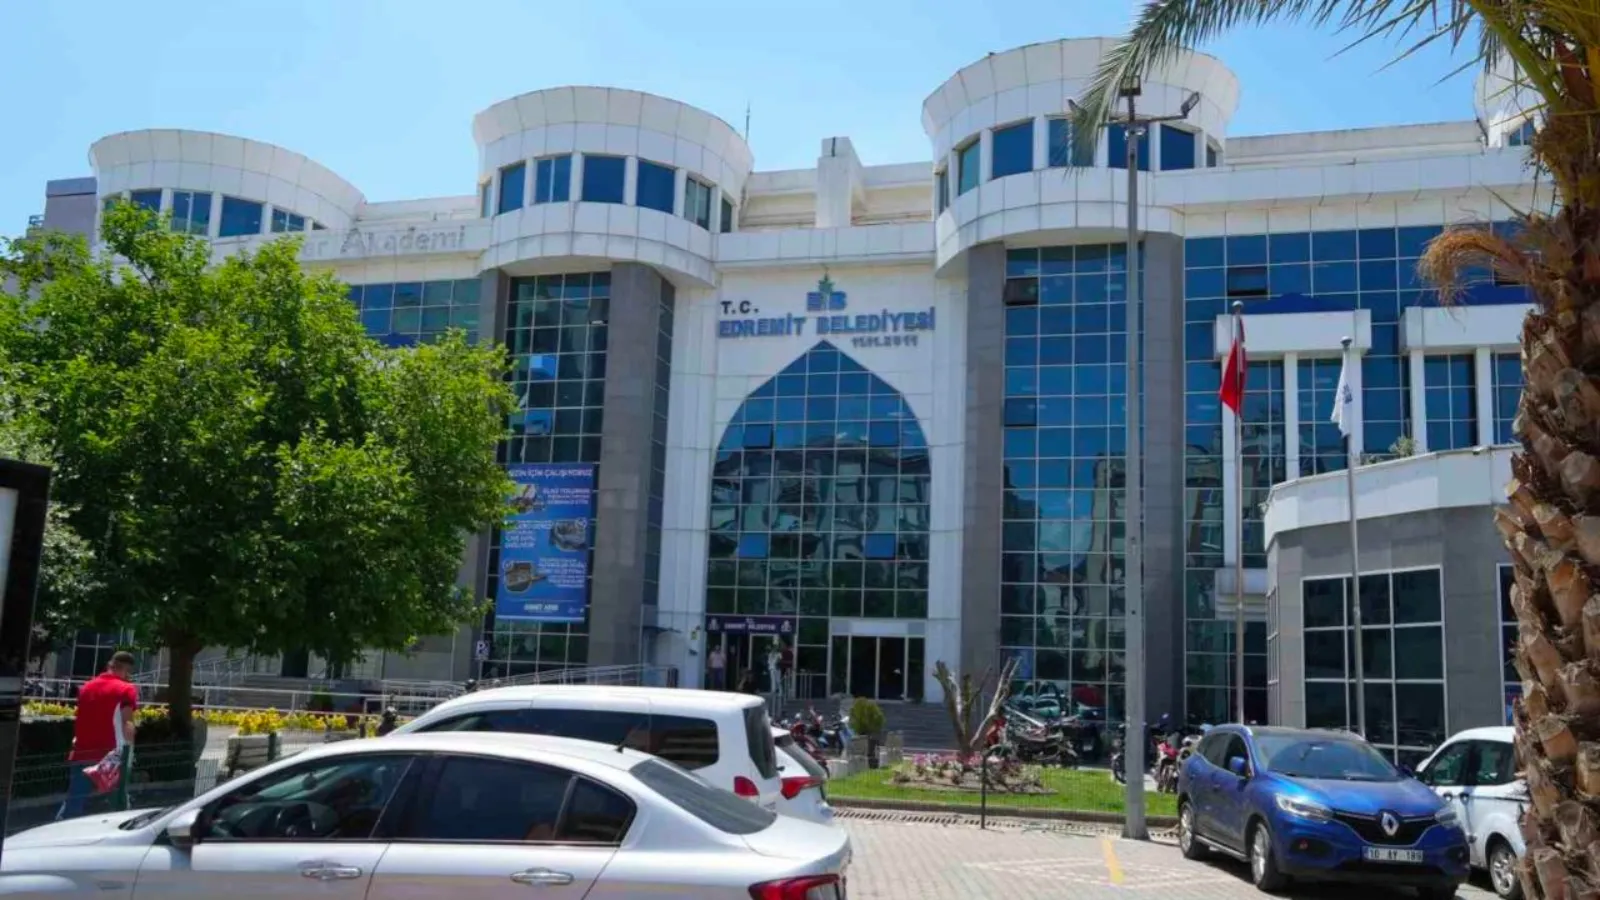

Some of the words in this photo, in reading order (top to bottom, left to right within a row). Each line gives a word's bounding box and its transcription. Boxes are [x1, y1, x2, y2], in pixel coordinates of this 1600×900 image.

[341, 224, 466, 252] Akademi
[720, 300, 760, 314] T.C.
[718, 312, 807, 338] EDREMİT
[816, 306, 936, 335] BELEDİYESİ
